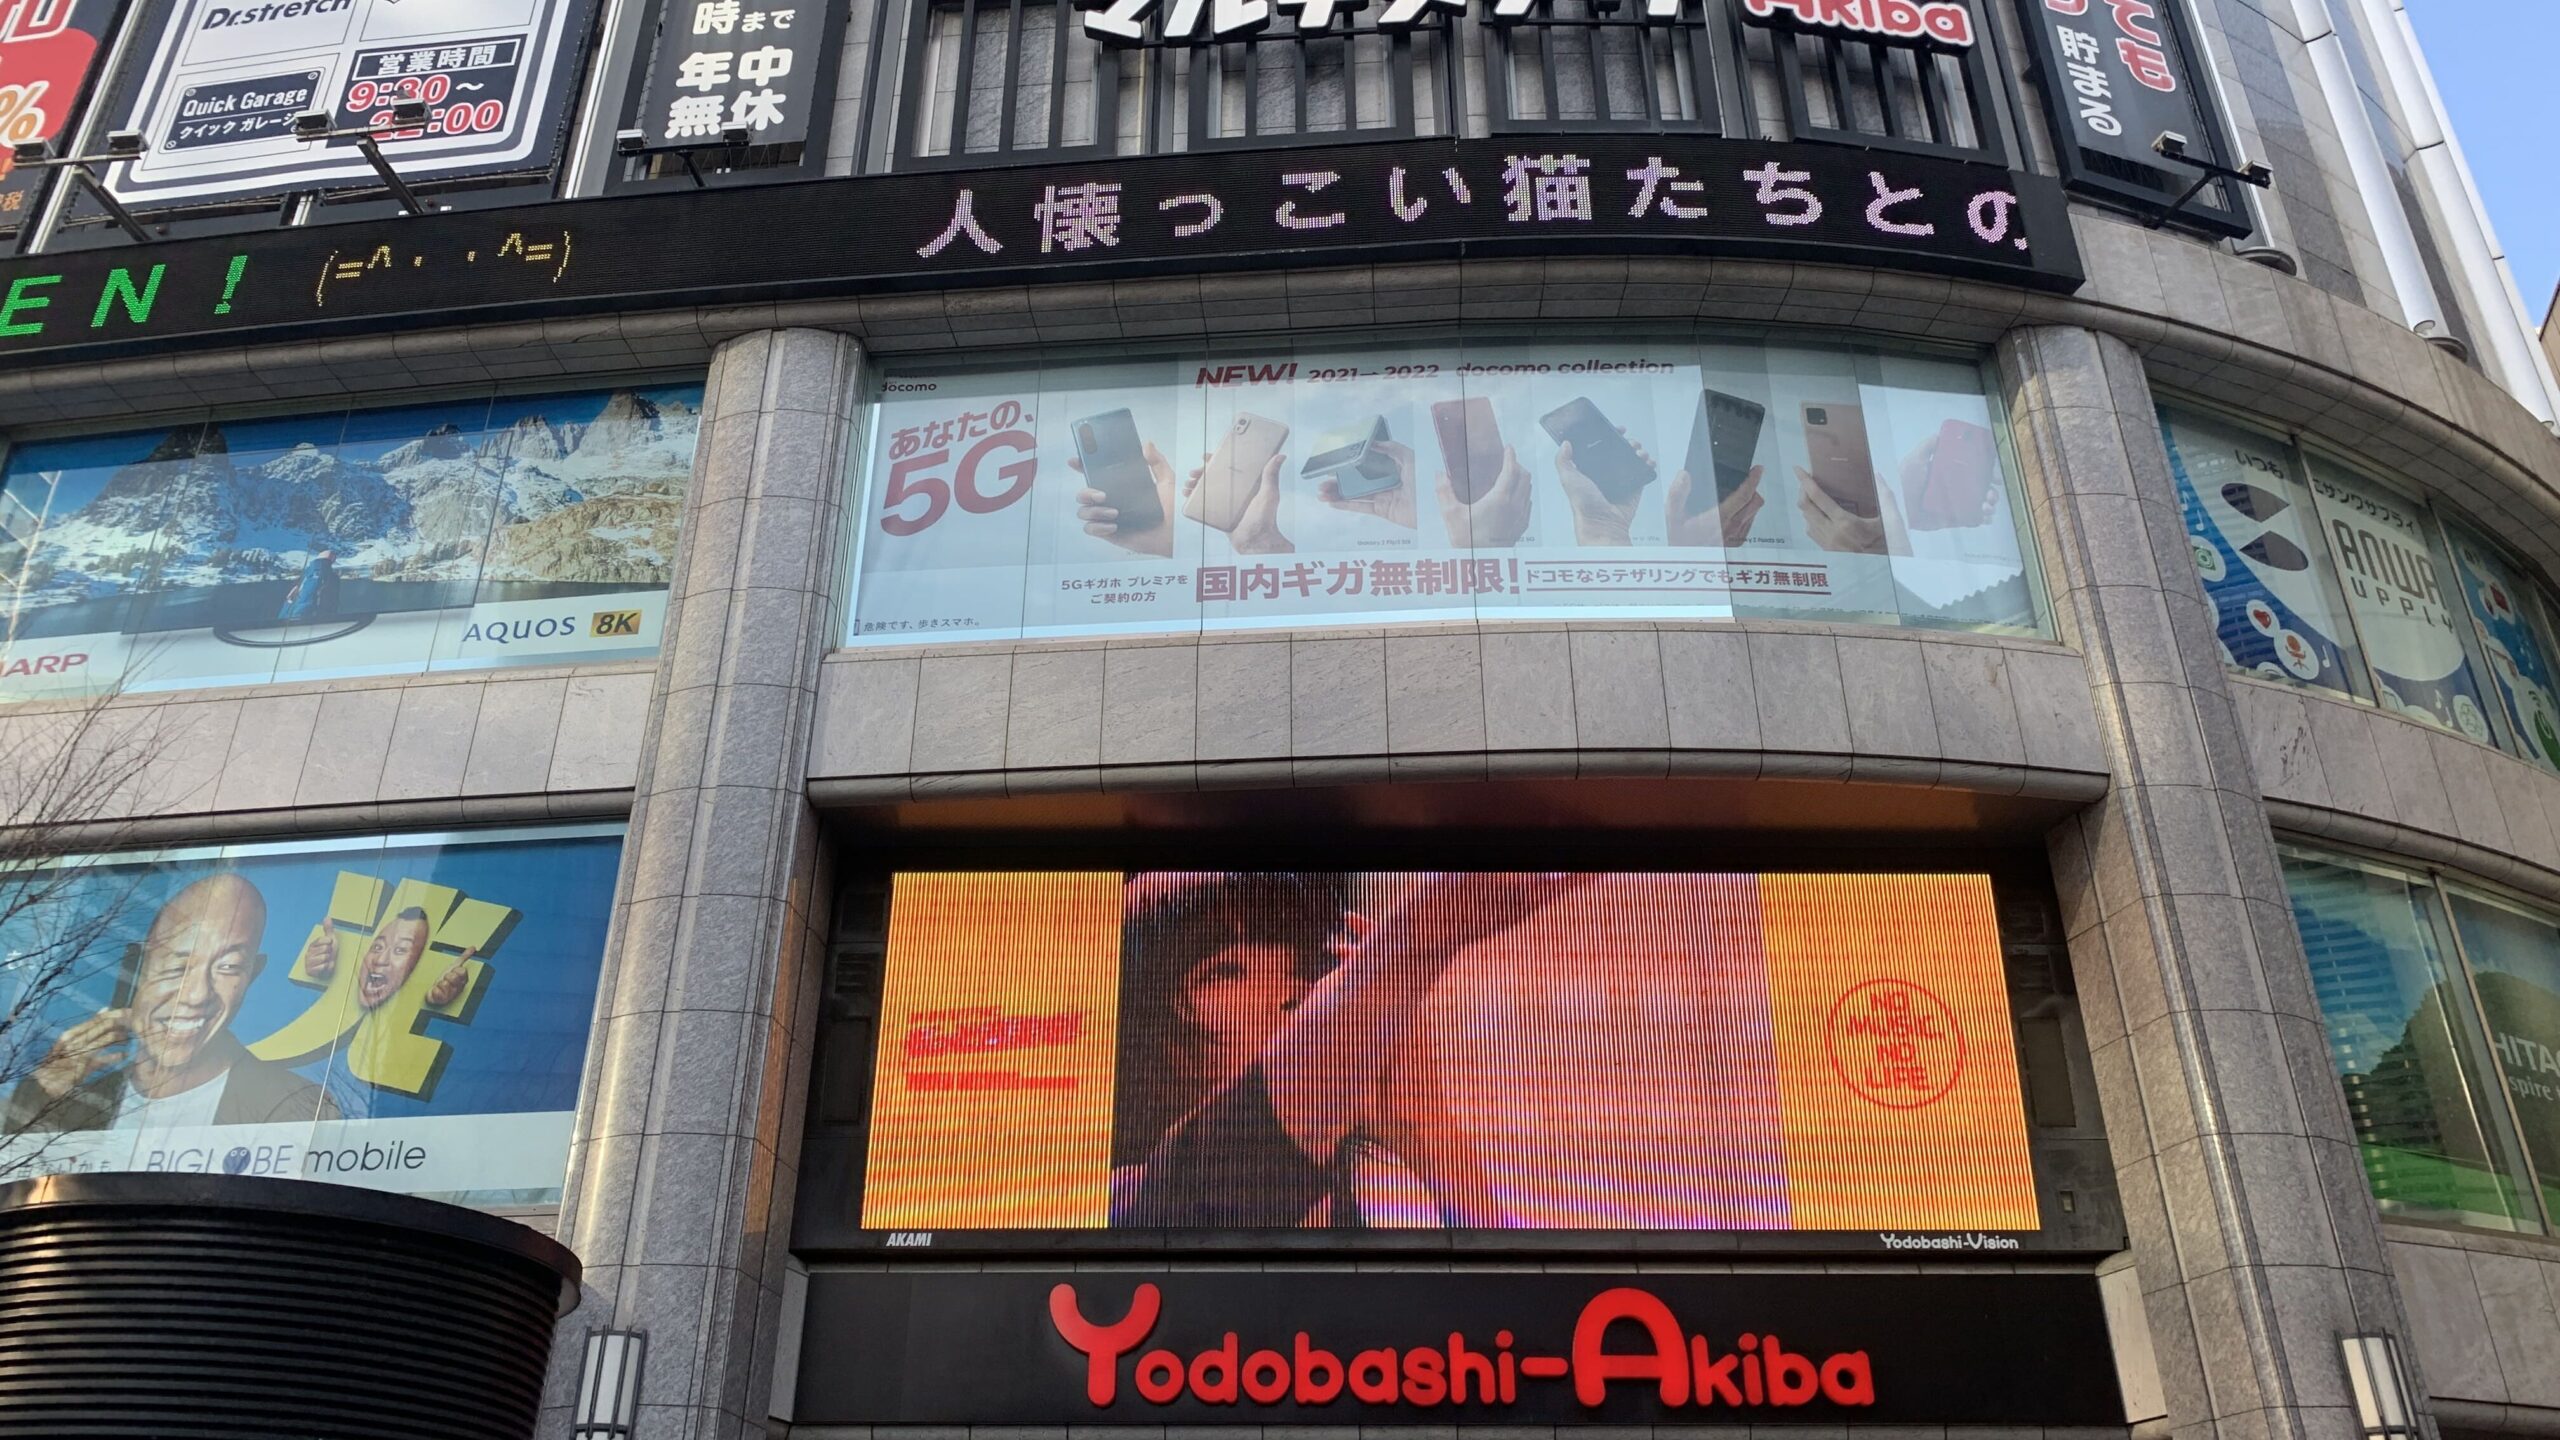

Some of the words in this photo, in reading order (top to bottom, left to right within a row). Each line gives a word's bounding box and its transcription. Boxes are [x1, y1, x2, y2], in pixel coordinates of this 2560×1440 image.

[377, 44, 497, 76] 営業時間
[675, 46, 793, 92] 年中
[2056, 25, 2122, 136] 貯まる
[182, 96, 237, 117] Quick
[239, 88, 308, 110] Garage
[665, 88, 787, 139] 無休
[179, 121, 237, 140] クイック
[916, 154, 2028, 259] 人懐っこい猫たちとの
[881, 382, 938, 393] docomo
[1195, 362, 1299, 389] NEW!
[1456, 362, 1552, 378] docomo
[1557, 358, 1675, 375] collection
[888, 400, 1035, 460] あなたの、
[2235, 449, 2285, 479] いつも
[880, 429, 1038, 537] 5G
[1196, 558, 1520, 603] 国内ギガ無制限!
[1526, 567, 1830, 589] ドコモならテザリングでもギガ無制限
[1090, 591, 1157, 605] ご契約の方
[462, 615, 576, 644] AQUOS
[596, 612, 638, 635] 8K
[304, 1140, 427, 1173] mobile
[885, 1232, 933, 1247] AKAMI
[1880, 1232, 2019, 1250] Yodobashi-Vision
[1048, 1282, 1876, 1407] Yodobashi-Akiba
